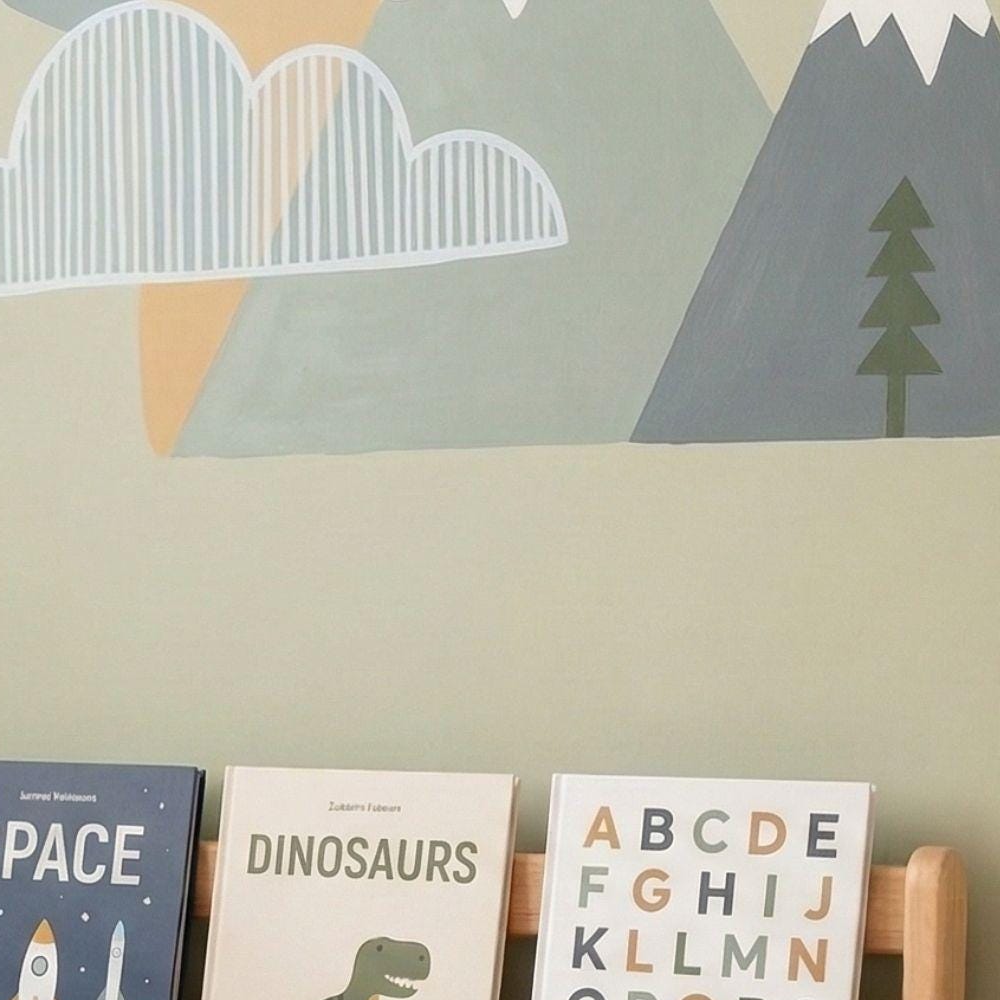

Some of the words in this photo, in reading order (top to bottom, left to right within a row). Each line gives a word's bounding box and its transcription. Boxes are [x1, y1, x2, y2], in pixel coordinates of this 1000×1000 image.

[246, 832, 479, 885] DINOSAURS
[582, 806, 621, 850] A
[640, 807, 675, 852] B
[693, 809, 731, 854] C
[748, 811, 788, 856] D
[806, 813, 840, 858] E
[578, 866, 609, 909] F
[632, 868, 672, 913] G
[697, 871, 736, 916] H
[804, 876, 833, 921] J
[571, 926, 609, 971] K
[625, 929, 654, 974] L
[674, 932, 702, 976] L
[721, 934, 767, 980] M
[787, 938, 829, 983] N
